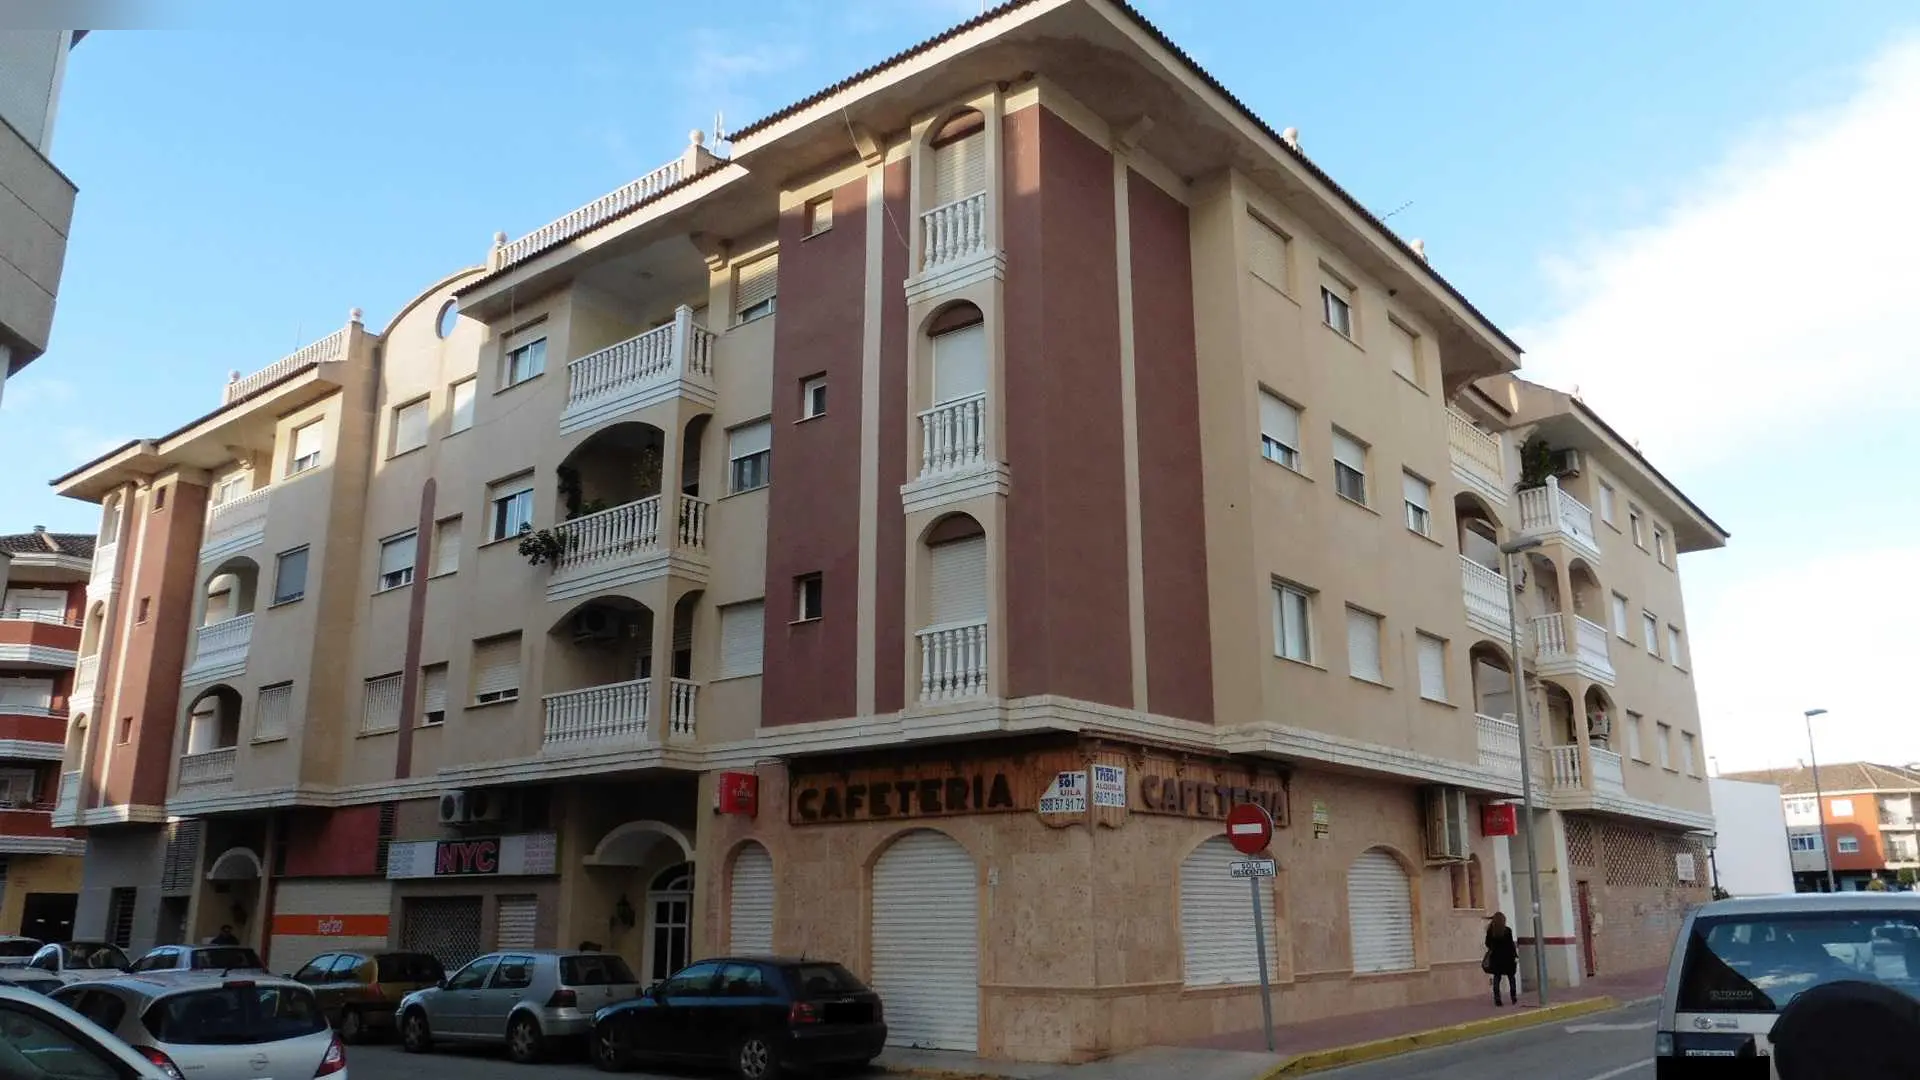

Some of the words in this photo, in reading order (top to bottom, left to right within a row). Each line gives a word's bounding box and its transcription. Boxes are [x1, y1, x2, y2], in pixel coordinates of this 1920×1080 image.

[797, 773, 1014, 819] CAFETERIA
[1040, 799, 1054, 811] 968
[1055, 799, 1064, 811] 57
[1065, 799, 1074, 810] 91
[1076, 798, 1085, 810] 72
[437, 840, 497, 874] NYC
